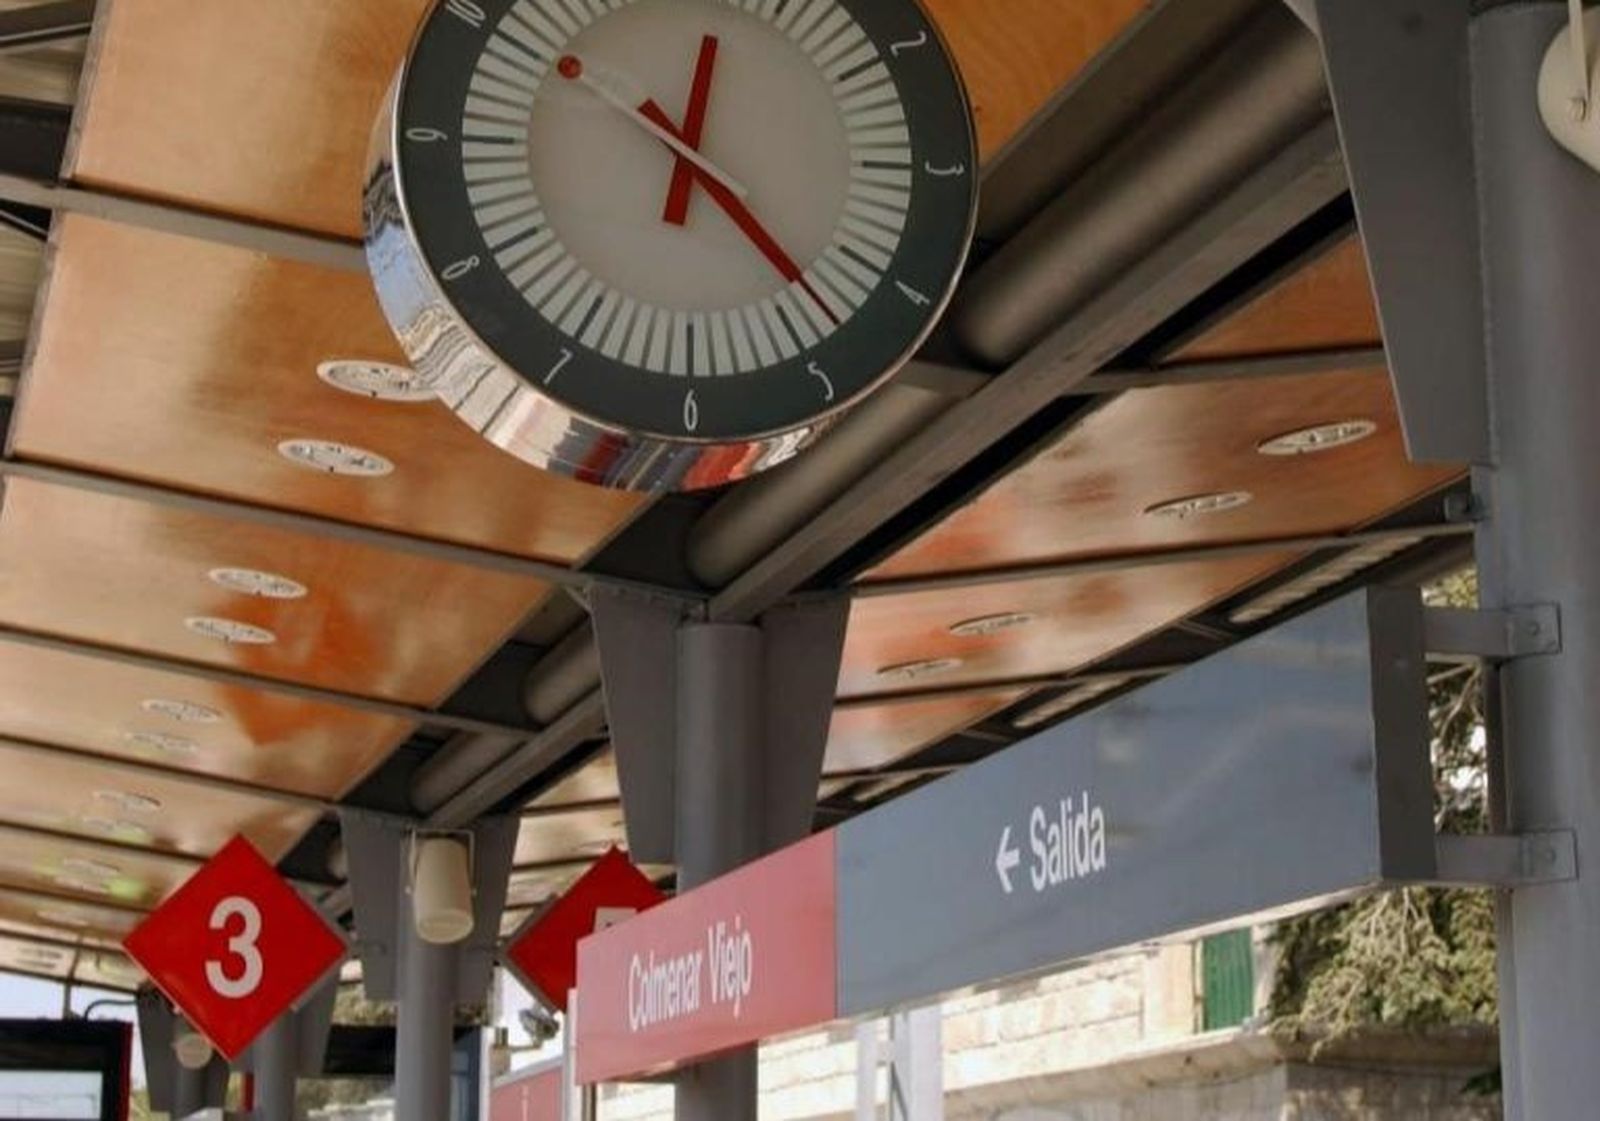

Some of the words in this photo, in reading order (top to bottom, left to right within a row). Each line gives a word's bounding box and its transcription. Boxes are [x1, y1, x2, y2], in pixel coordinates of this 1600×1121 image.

[890, 31, 927, 57] 2
[405, 127, 448, 142] 9
[925, 160, 965, 176] 3
[441, 254, 481, 281] 8
[895, 280, 931, 306] 4
[543, 349, 573, 384] 7
[807, 361, 835, 401] 5
[682, 389, 699, 432] 6
[1029, 790, 1106, 892] Salida
[205, 896, 263, 999] 3
[628, 948, 703, 1033] Colmenar
[708, 915, 753, 1018] Viejo
